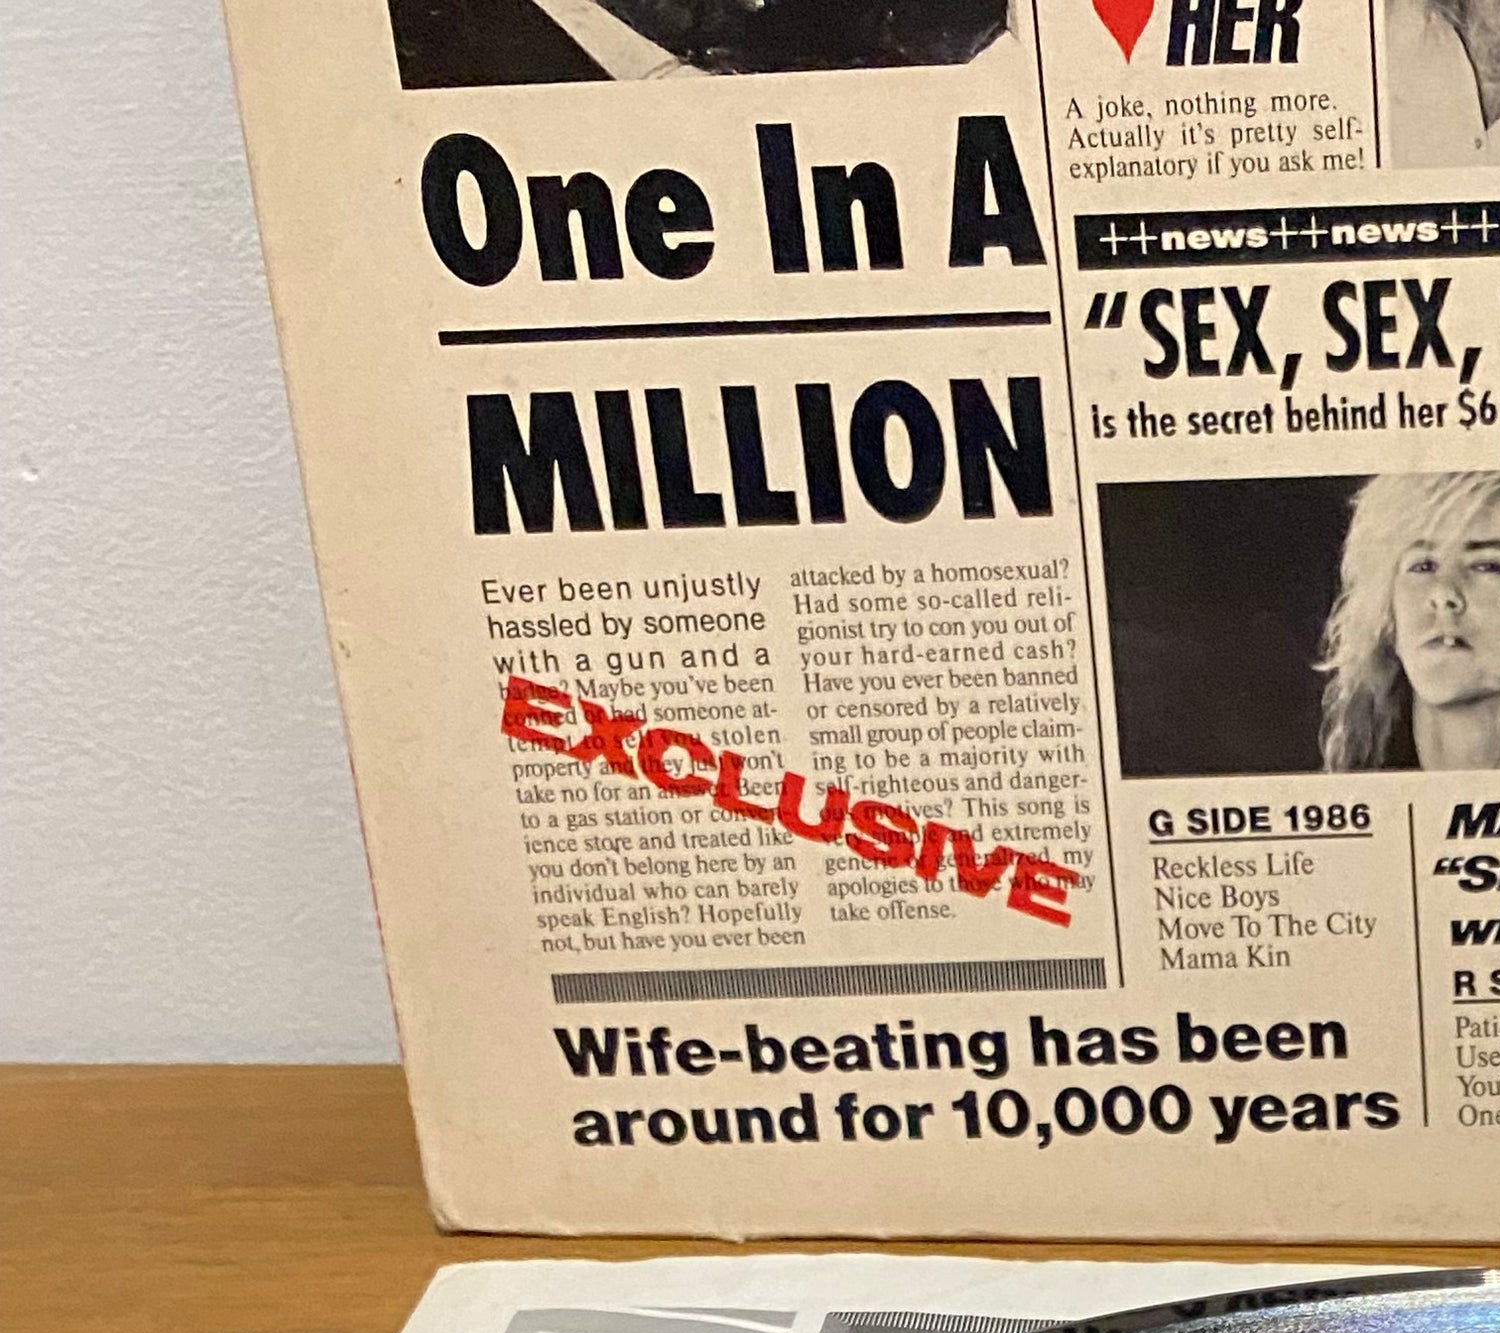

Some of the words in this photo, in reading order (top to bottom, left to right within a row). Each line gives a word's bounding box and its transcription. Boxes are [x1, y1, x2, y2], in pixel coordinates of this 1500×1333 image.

[1166, 0, 1299, 66] HER
[1067, 97, 1082, 120] A
[1097, 96, 1153, 122] joke,
[1165, 93, 1257, 118] nothing
[1271, 90, 1336, 113] more.
[1068, 123, 1165, 151] Actually
[1181, 123, 1215, 147] it's
[1230, 123, 1298, 148] pretty
[1313, 118, 1364, 141] self-
[1069, 153, 1197, 183] explanatory
[1206, 151, 1222, 175] if
[1230, 153, 1270, 178] you
[1279, 150, 1315, 173] ask
[1323, 148, 1365, 170] me!
[421, 134, 715, 287] One
[755, 123, 903, 274] In
[949, 116, 1047, 269] A
[1324, 277, 1483, 384] SEX,
[1127, 404, 1177, 438] the
[1188, 402, 1274, 436] secret
[1285, 396, 1385, 433] behind
[1399, 393, 1446, 429] her
[1459, 389, 1497, 430] $6
[466, 376, 1053, 534] MILLION
[482, 579, 546, 604] Ever
[558, 577, 632, 601] been
[644, 572, 761, 600] unjustly
[488, 613, 591, 638] hassled
[602, 613, 632, 639] by
[644, 611, 765, 634] someone
[493, 649, 560, 674] with
[576, 653, 590, 671] a
[607, 649, 665, 675] gun
[682, 643, 739, 668] and
[756, 648, 770, 665] a
[501, 674, 1079, 928] EXCLUSIVE
[1148, 808, 1173, 837] G
[1186, 806, 1272, 835] SIDE
[1284, 803, 1370, 831] 1986
[1152, 853, 1256, 882] Reckless
[1266, 851, 1315, 876] Life
[1155, 887, 1210, 911] Nice
[1222, 885, 1280, 909] Boys
[1158, 918, 1224, 941] Move
[1231, 916, 1260, 937] To
[1272, 915, 1319, 936] The
[1326, 912, 1377, 939] City
[1160, 946, 1238, 971] Mama
[1247, 944, 1290, 967] Kin
[1455, 970, 1477, 996] R
[554, 1020, 1007, 1078] Wife-beating
[1028, 1014, 1158, 1068] has
[1177, 1010, 1348, 1063] been
[573, 1092, 814, 1146] around
[834, 1090, 933, 1141] for
[951, 1084, 1191, 1150] 10,000
[1210, 1085, 1400, 1145] years
